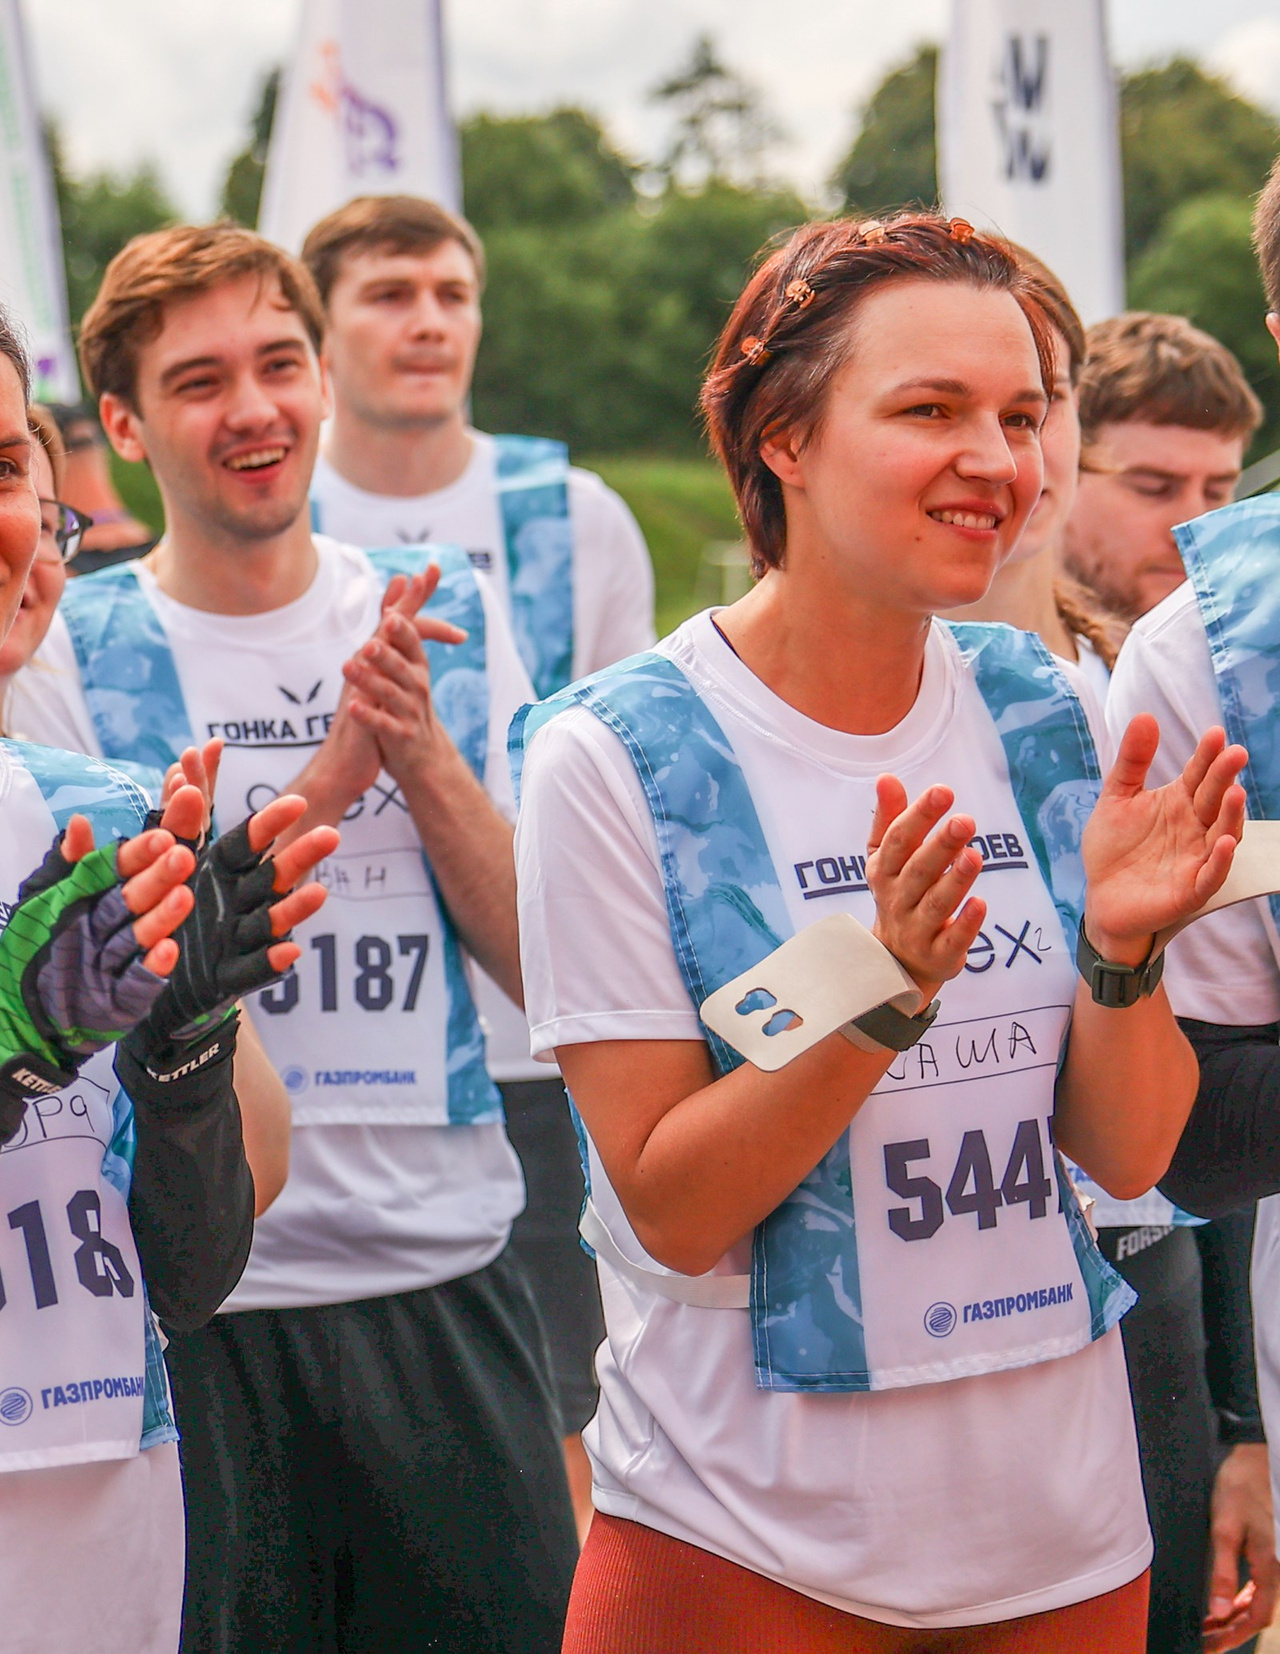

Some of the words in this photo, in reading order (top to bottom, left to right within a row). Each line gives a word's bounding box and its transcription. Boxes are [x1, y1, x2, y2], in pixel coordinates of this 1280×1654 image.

[207, 718, 298, 741] ГОНКА
[314, 1070, 418, 1086] ГАЗПРОМБАНК
[883, 1115, 1064, 1242] 544
[963, 1283, 1074, 1314] ГАЗПРОМБАНК
